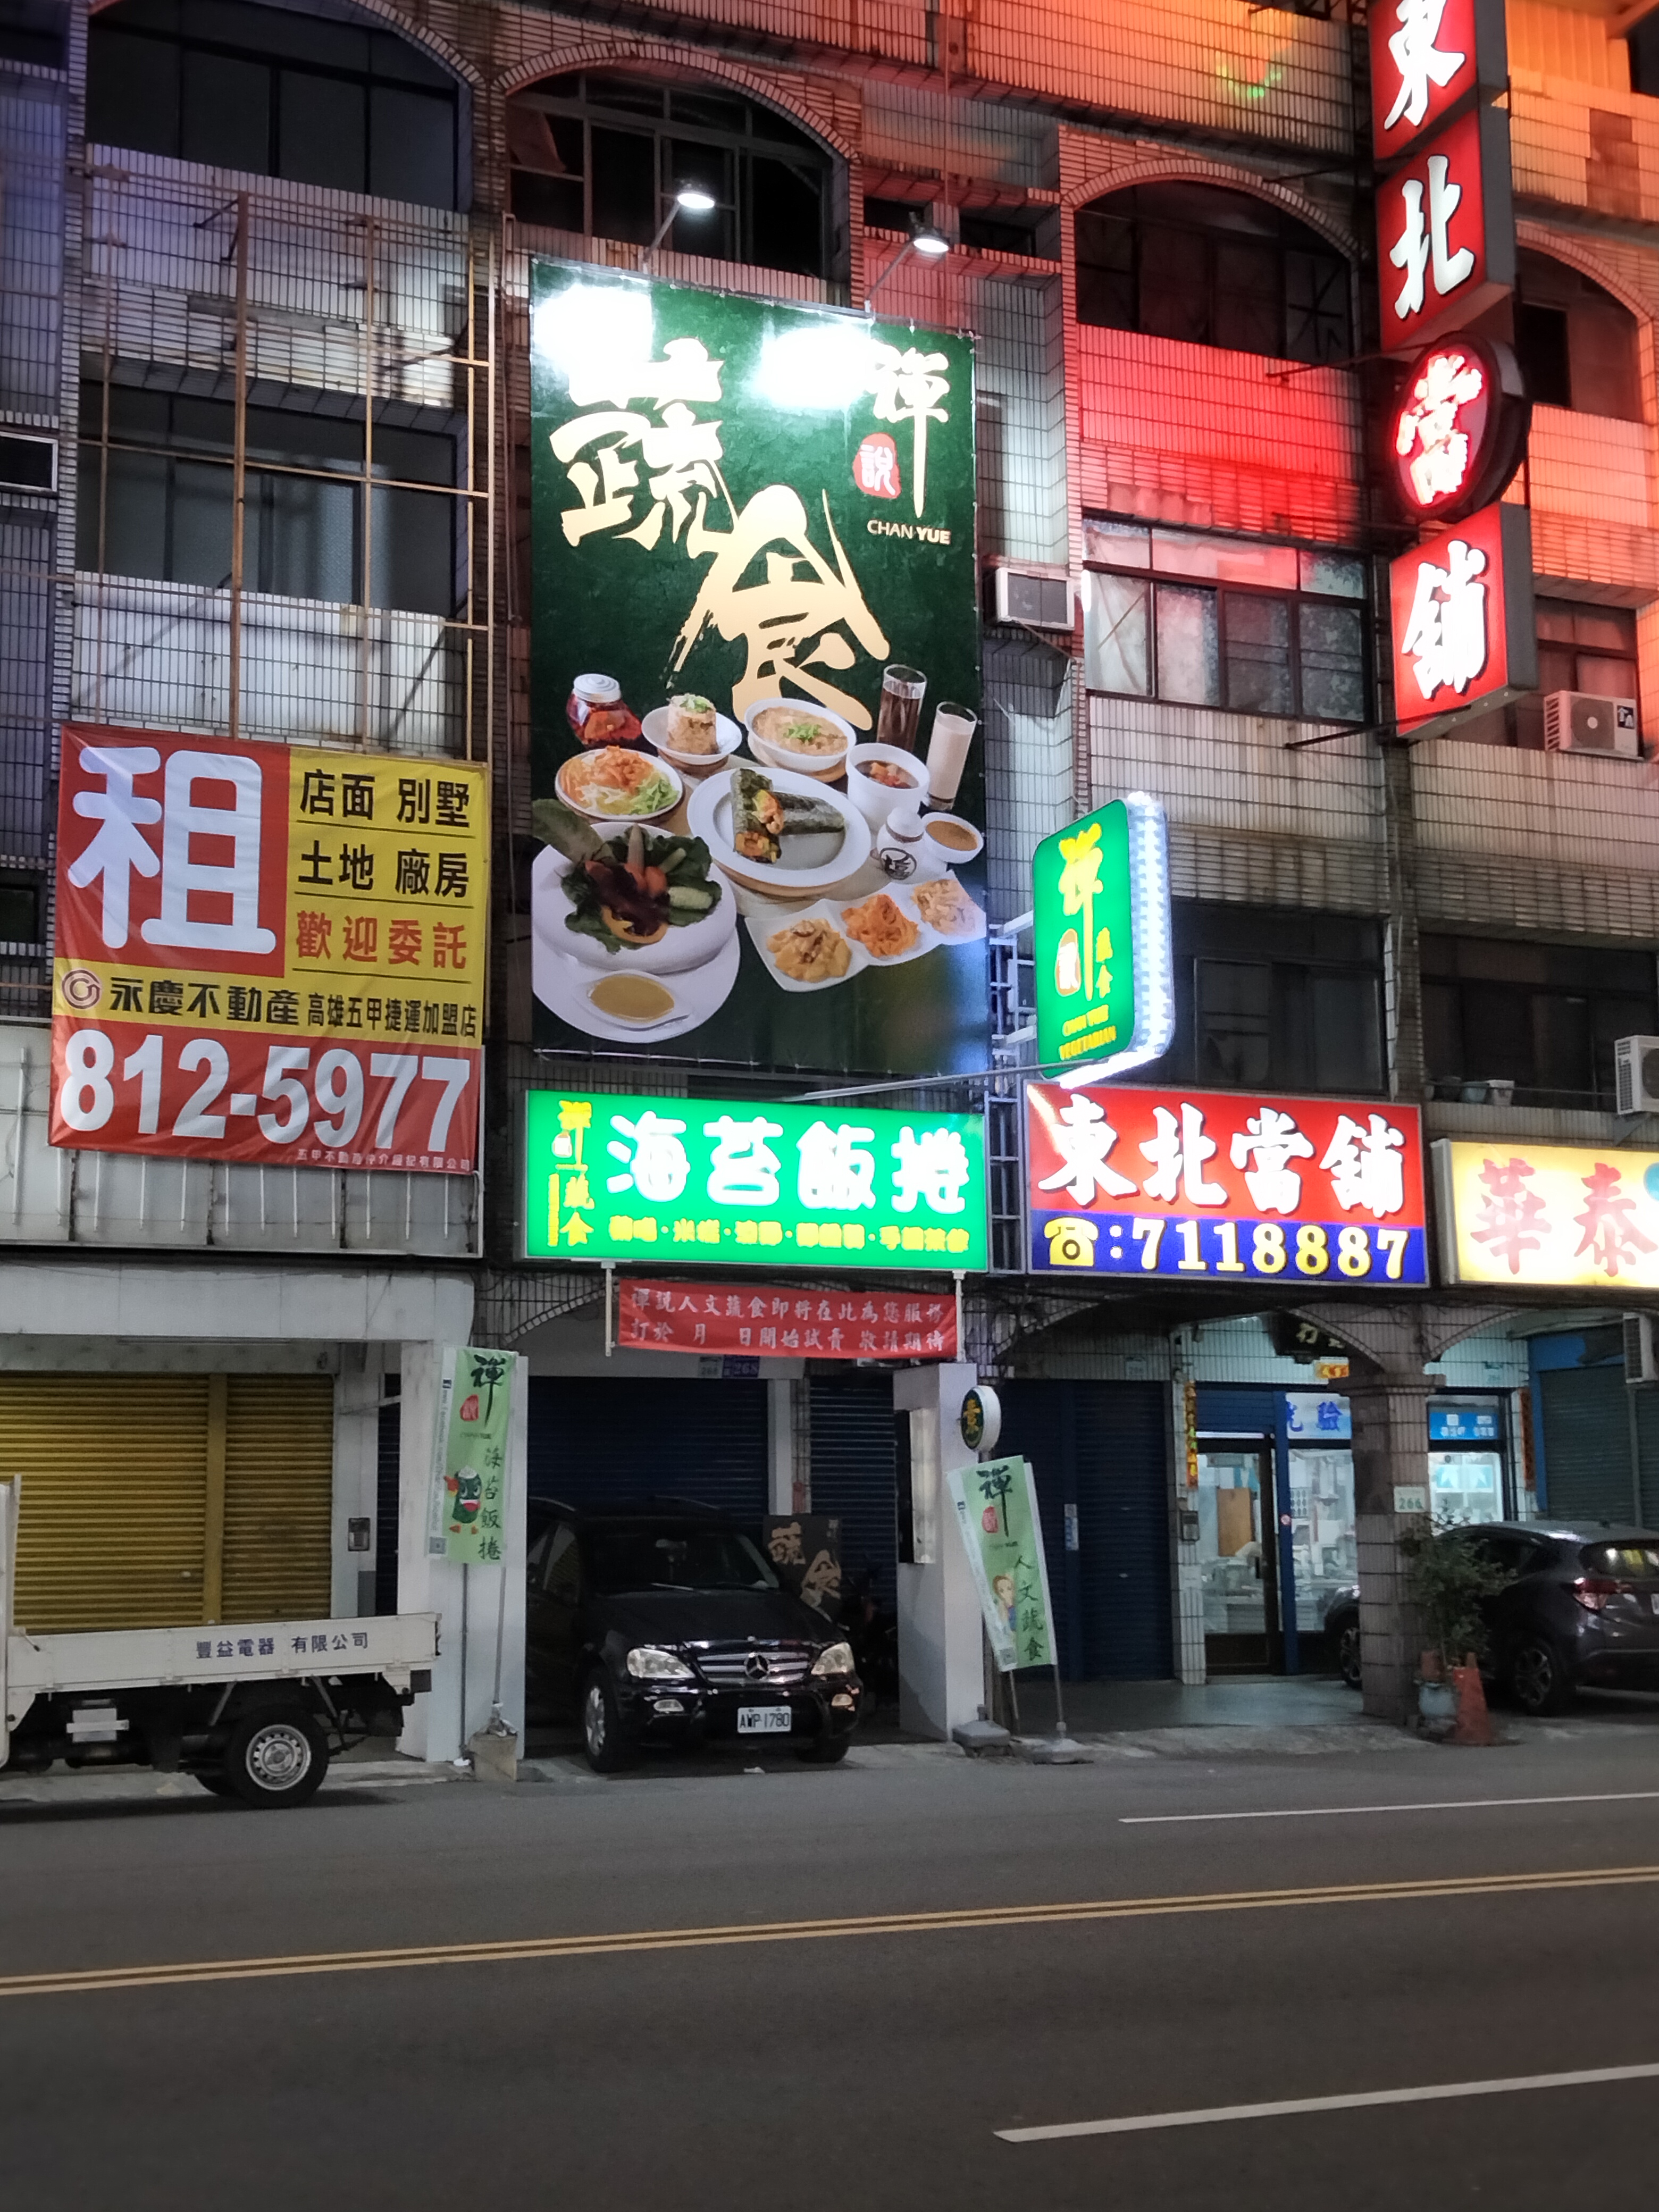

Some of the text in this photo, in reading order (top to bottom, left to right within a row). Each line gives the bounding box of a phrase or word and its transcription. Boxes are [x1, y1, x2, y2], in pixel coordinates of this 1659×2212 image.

[867, 519, 951, 546] CHAN YUE
[299, 768, 471, 828] 店面 別墅
[67, 745, 277, 955] 租
[298, 840, 470, 898] 土地 廠房
[296, 910, 467, 969] 歡迎委託
[110, 976, 477, 1038] 永慶不動產 高雄五甲捷運加盟店
[60, 1029, 472, 1152] 812-5977
[1470, 1158, 1658, 1277] 華泰
[291, 1631, 368, 1654] 有限公司
